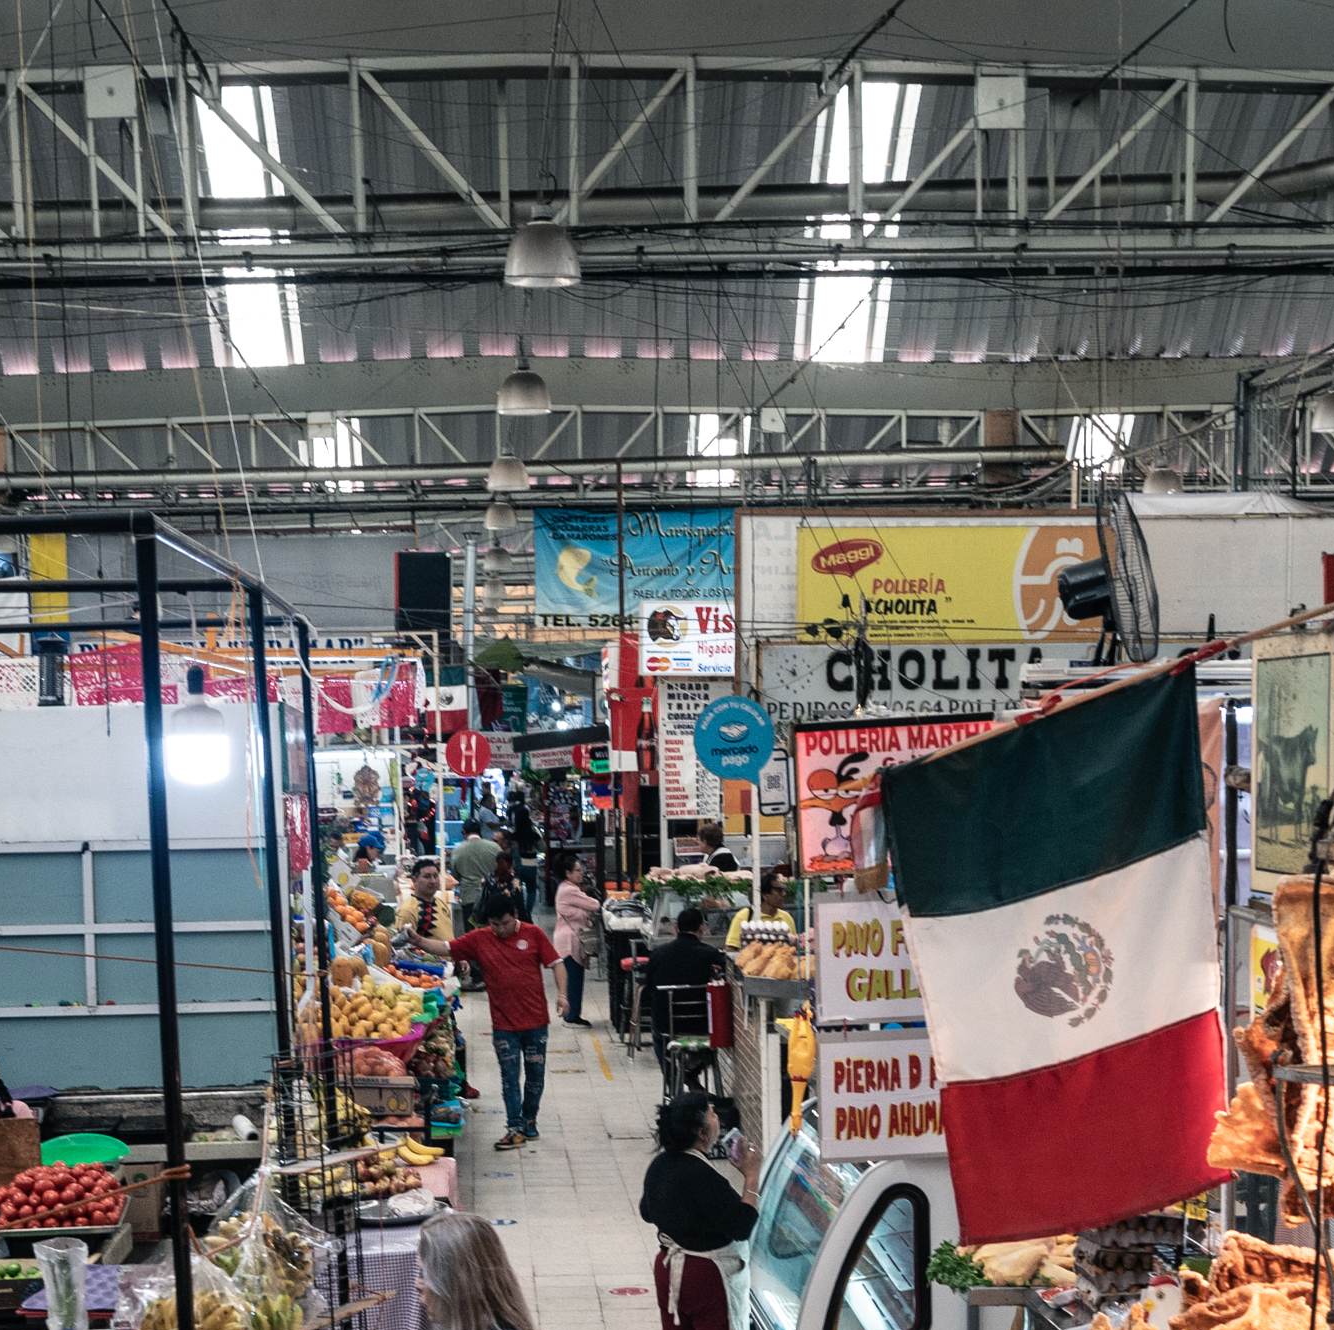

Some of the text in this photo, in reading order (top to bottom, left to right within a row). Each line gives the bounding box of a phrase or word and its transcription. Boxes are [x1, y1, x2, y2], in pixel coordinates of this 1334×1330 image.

[627, 511, 735, 546] Marisqueri
[819, 544, 875, 569] Maggi
[667, 703, 709, 711] TRIP
[711, 744, 759, 757] mercado
[805, 728, 899, 757] POLLERIA
[721, 754, 750, 767] pago
[832, 917, 885, 958] PAVO
[834, 1103, 882, 1141] PAVO
